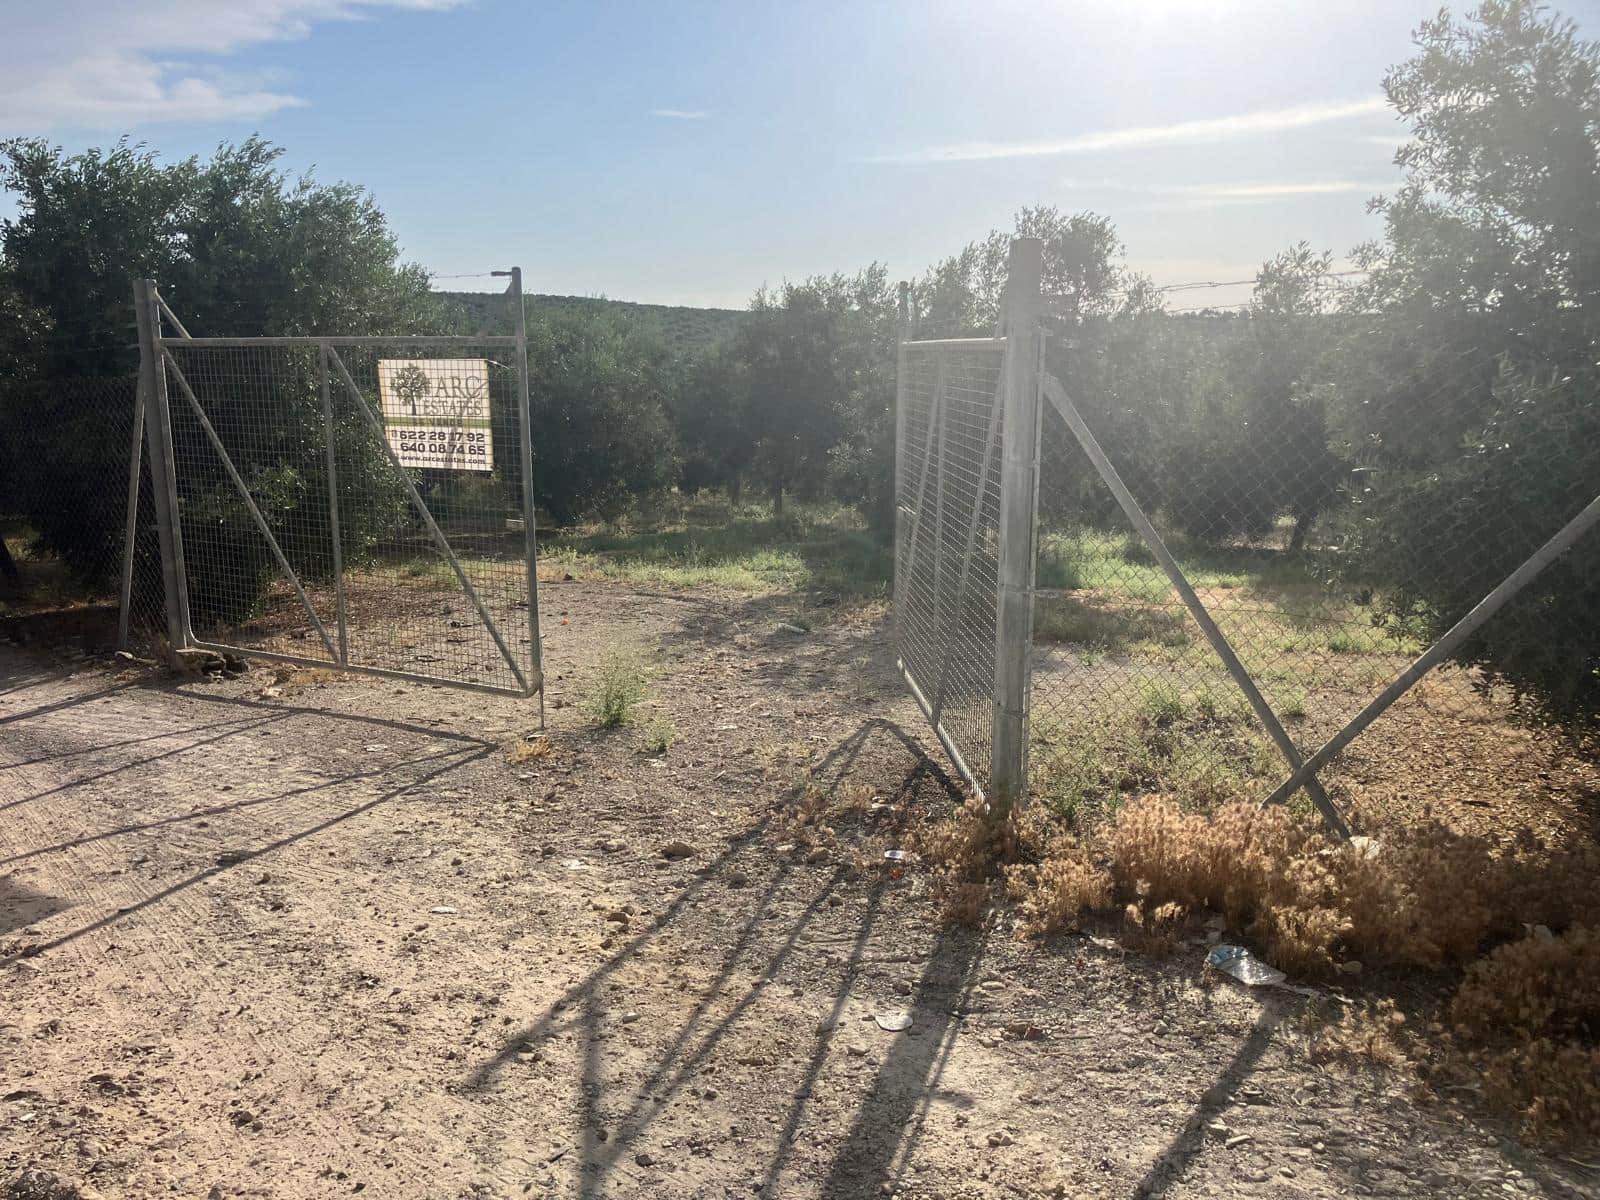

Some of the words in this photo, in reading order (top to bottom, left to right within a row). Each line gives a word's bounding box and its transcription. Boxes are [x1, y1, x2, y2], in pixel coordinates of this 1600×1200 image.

[436, 376, 488, 398] ARC
[423, 400, 482, 416] ESTATES
[399, 431, 426, 440] 622
[429, 431, 446, 440] 28
[450, 432, 463, 441] 17
[467, 433, 485, 442] 92
[400, 443, 425, 452] 640
[429, 443, 446, 454] 08
[450, 445, 464, 454] 74
[468, 446, 485, 455] 65
